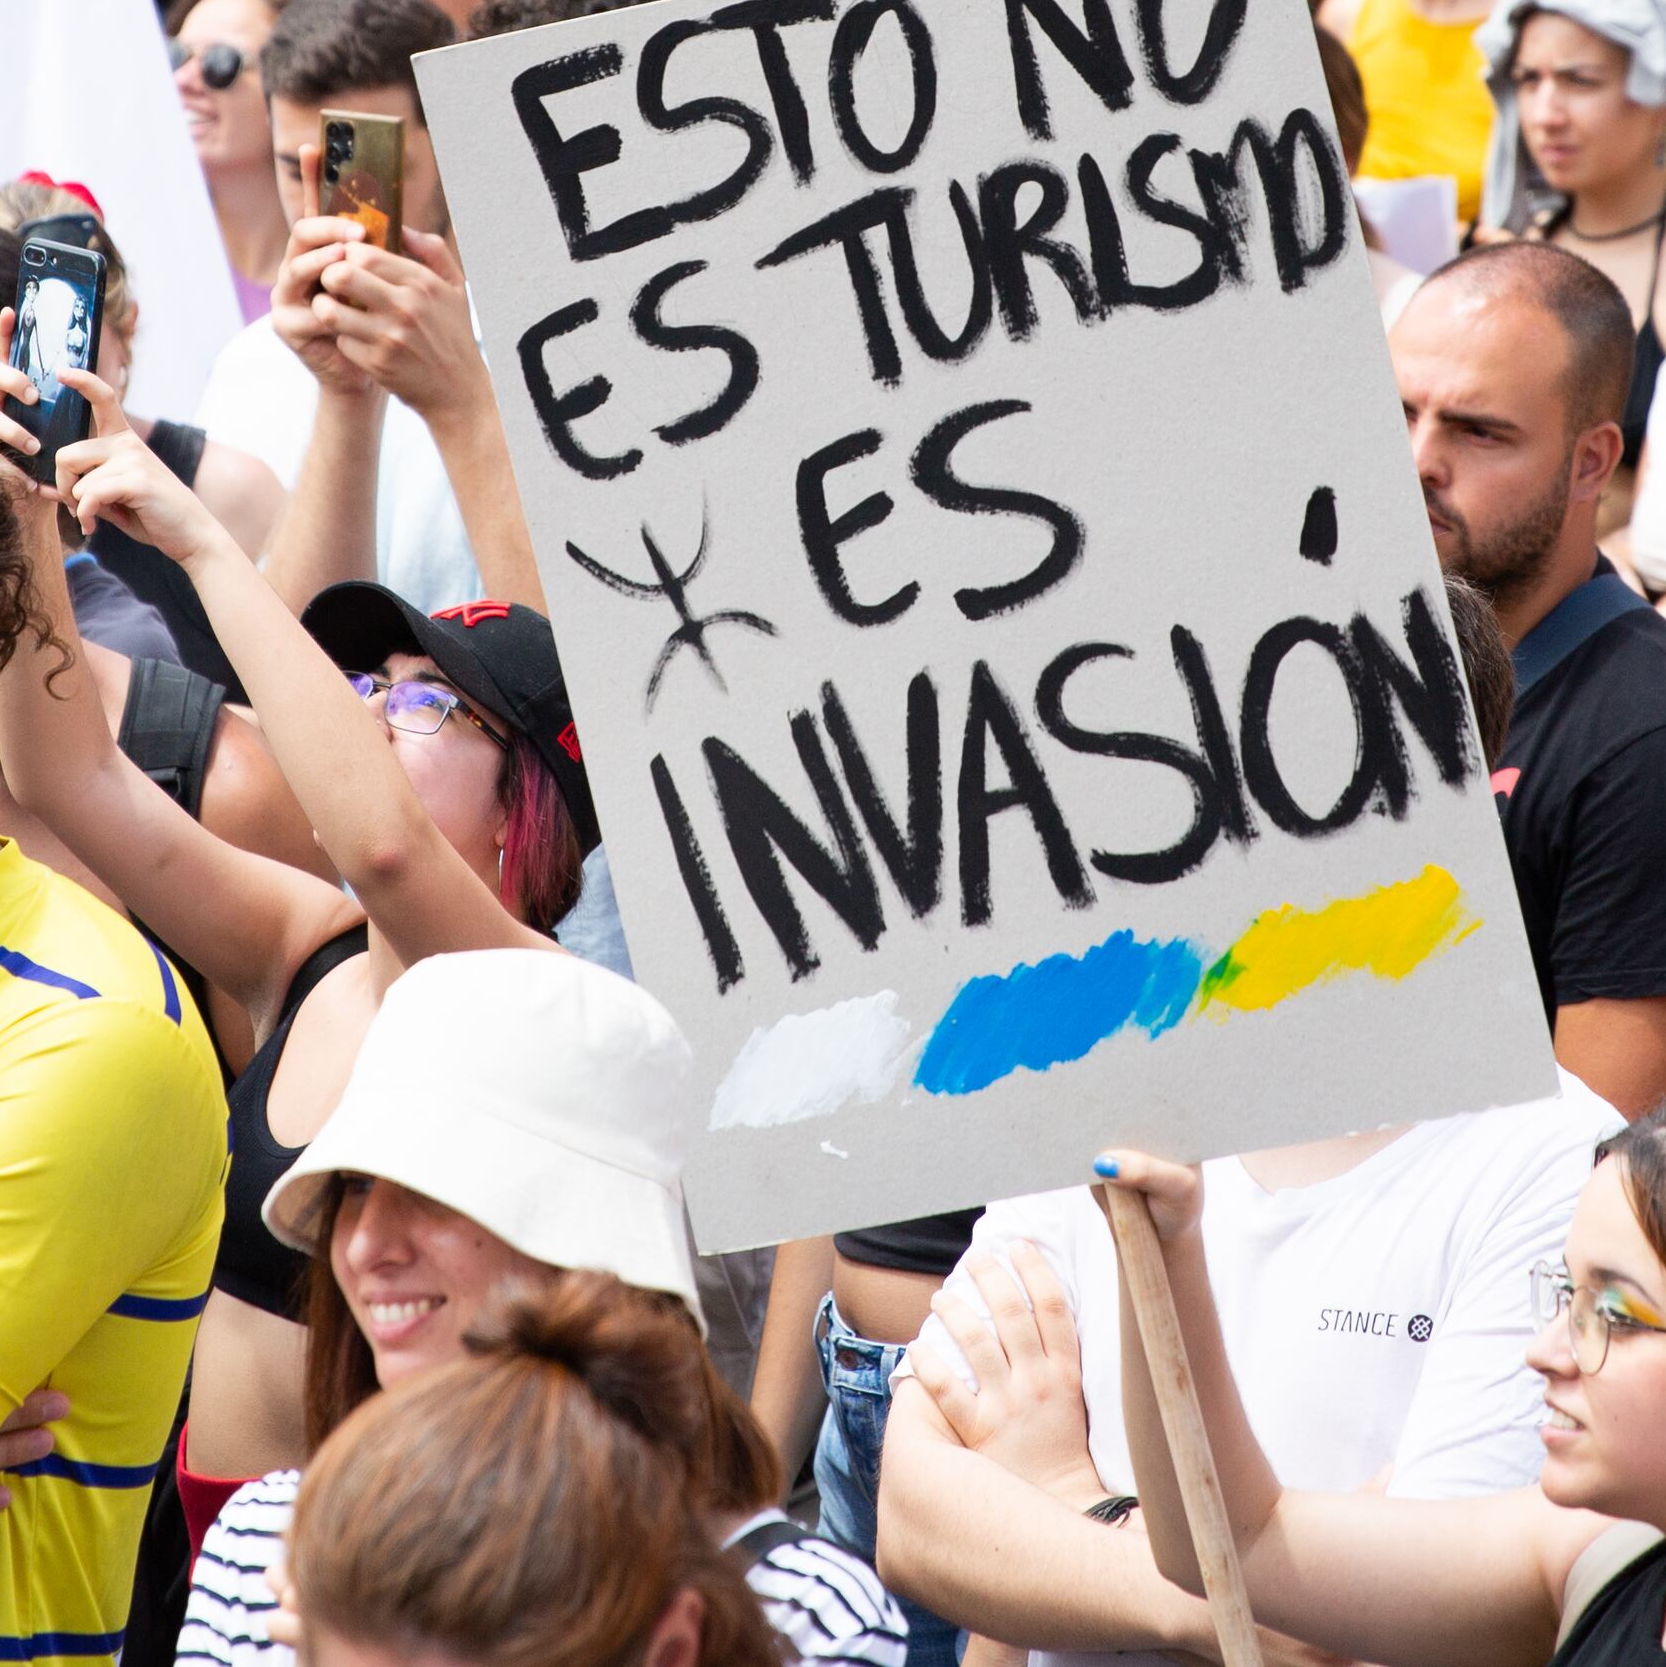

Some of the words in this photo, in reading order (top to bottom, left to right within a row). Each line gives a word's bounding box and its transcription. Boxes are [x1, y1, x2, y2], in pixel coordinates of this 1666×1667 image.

[516, 258, 762, 481] ES
[794, 398, 1087, 628] ES
[649, 485, 1480, 996] INVASIÓN
[1317, 1307, 1400, 1338] STANCE
